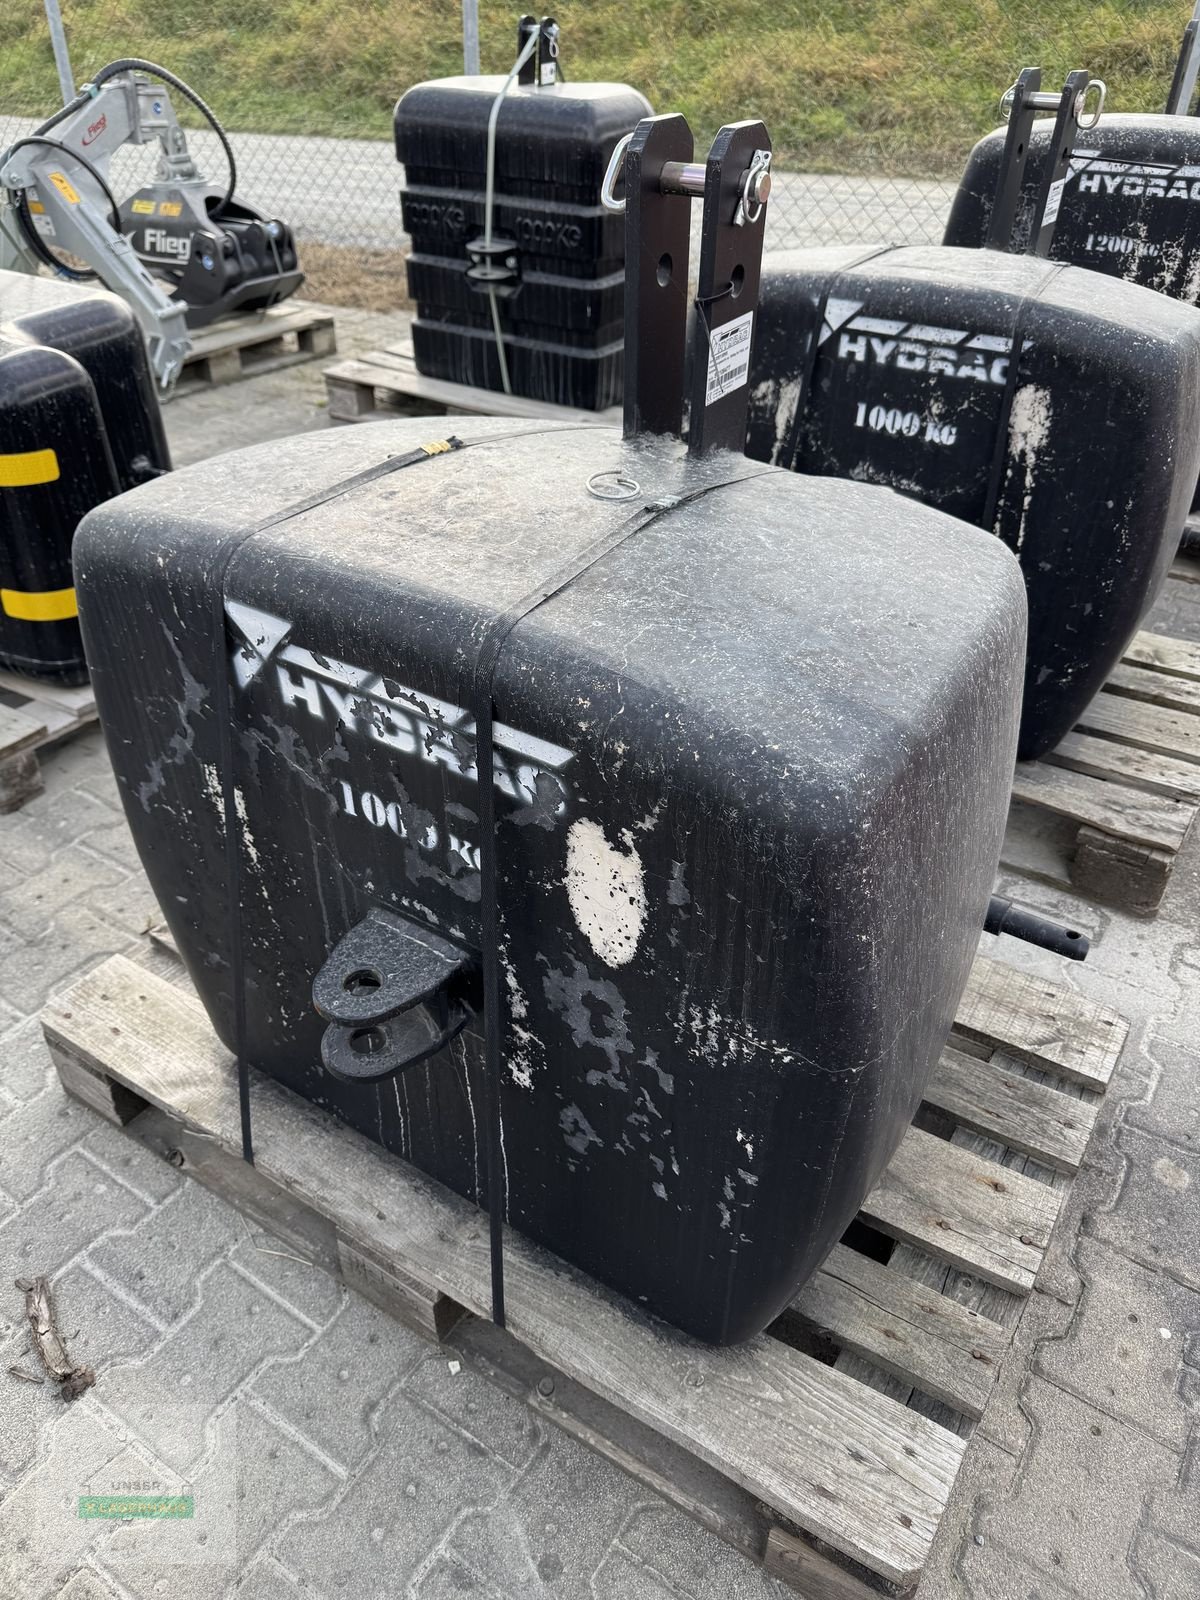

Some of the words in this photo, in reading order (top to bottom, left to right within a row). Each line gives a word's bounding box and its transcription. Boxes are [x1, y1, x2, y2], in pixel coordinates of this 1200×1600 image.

[1085, 233, 1134, 254] 1200
[855, 402, 921, 437] 1000
[924, 422, 957, 446] KG
